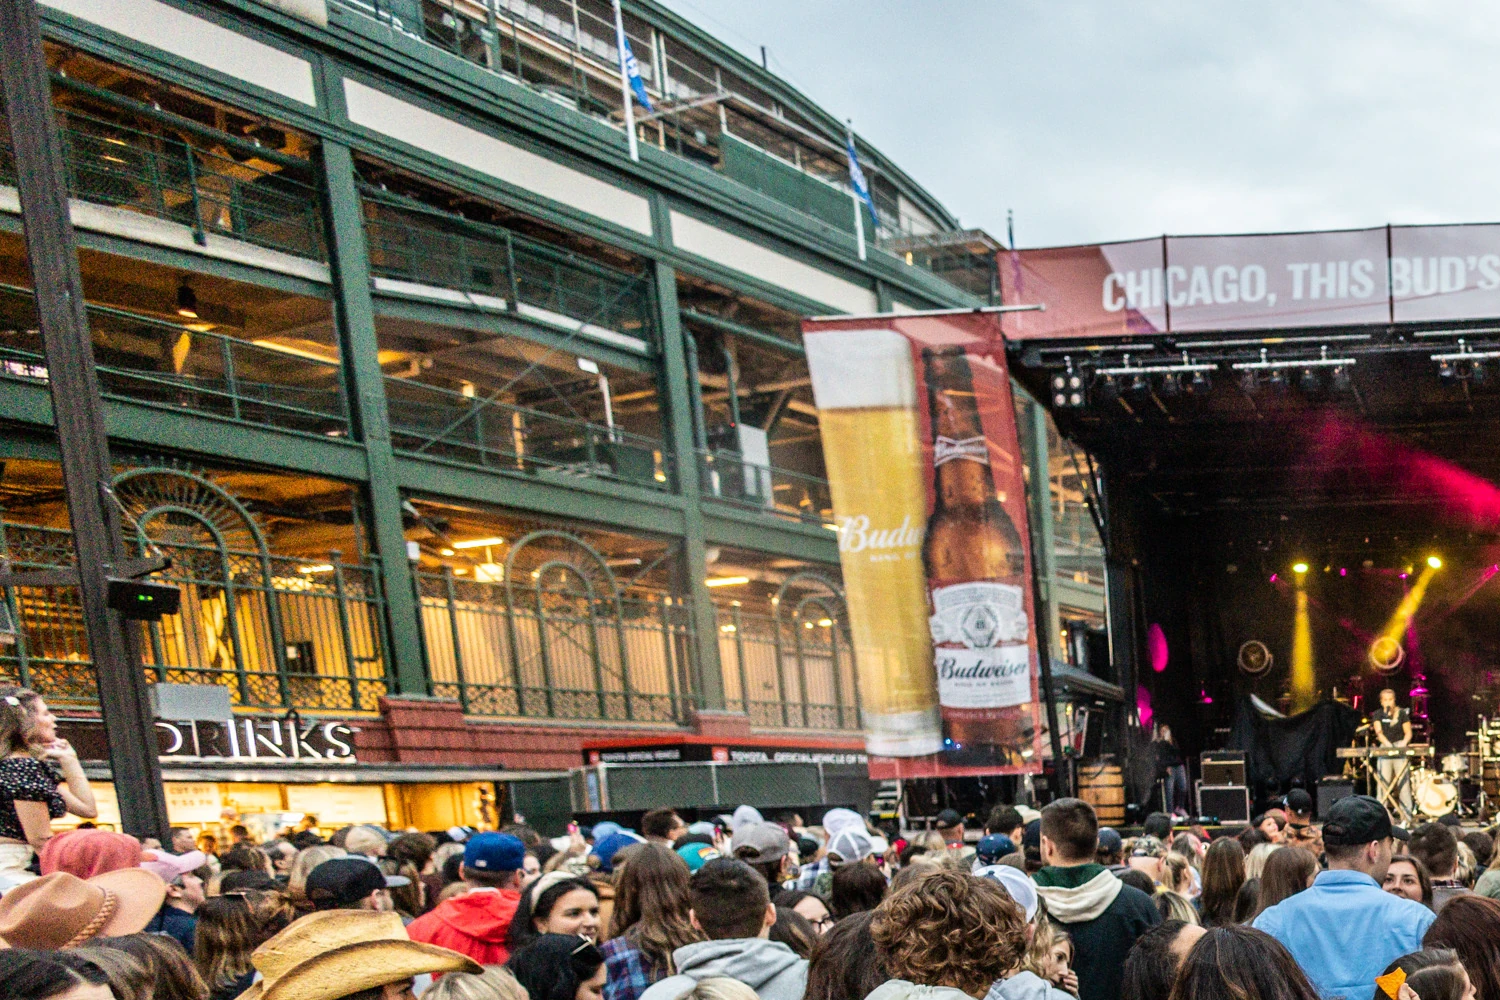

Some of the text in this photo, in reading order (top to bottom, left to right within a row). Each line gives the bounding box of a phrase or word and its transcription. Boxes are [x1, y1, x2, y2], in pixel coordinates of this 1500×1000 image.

[1102, 264, 1278, 312] CHICAGO,
[1287, 258, 1376, 301] THIS
[938, 657, 1027, 680] Budweiser
